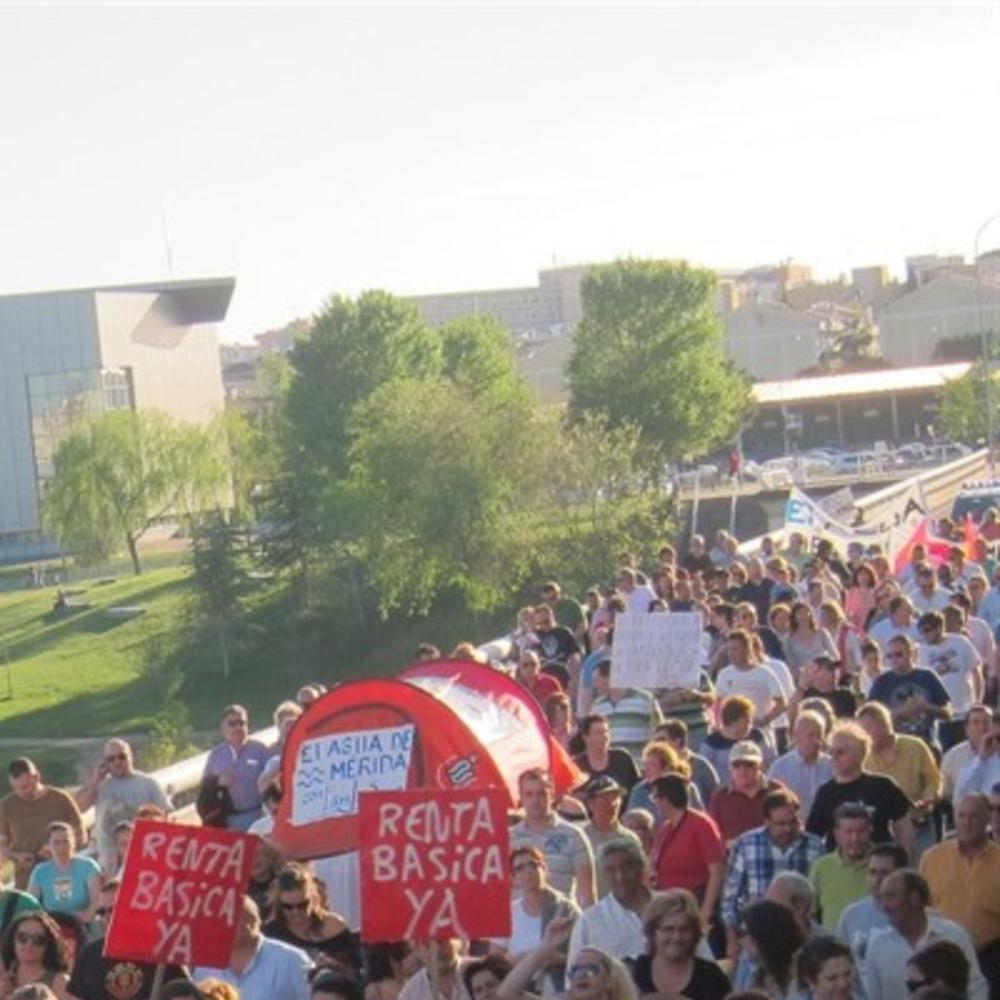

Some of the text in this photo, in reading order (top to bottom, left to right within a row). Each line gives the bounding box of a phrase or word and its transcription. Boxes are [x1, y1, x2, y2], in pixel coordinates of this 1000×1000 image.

[378, 797, 494, 843] RENTA
[142, 831, 245, 882] RENTA
[402, 887, 470, 940] YA
[153, 918, 191, 963] YA
